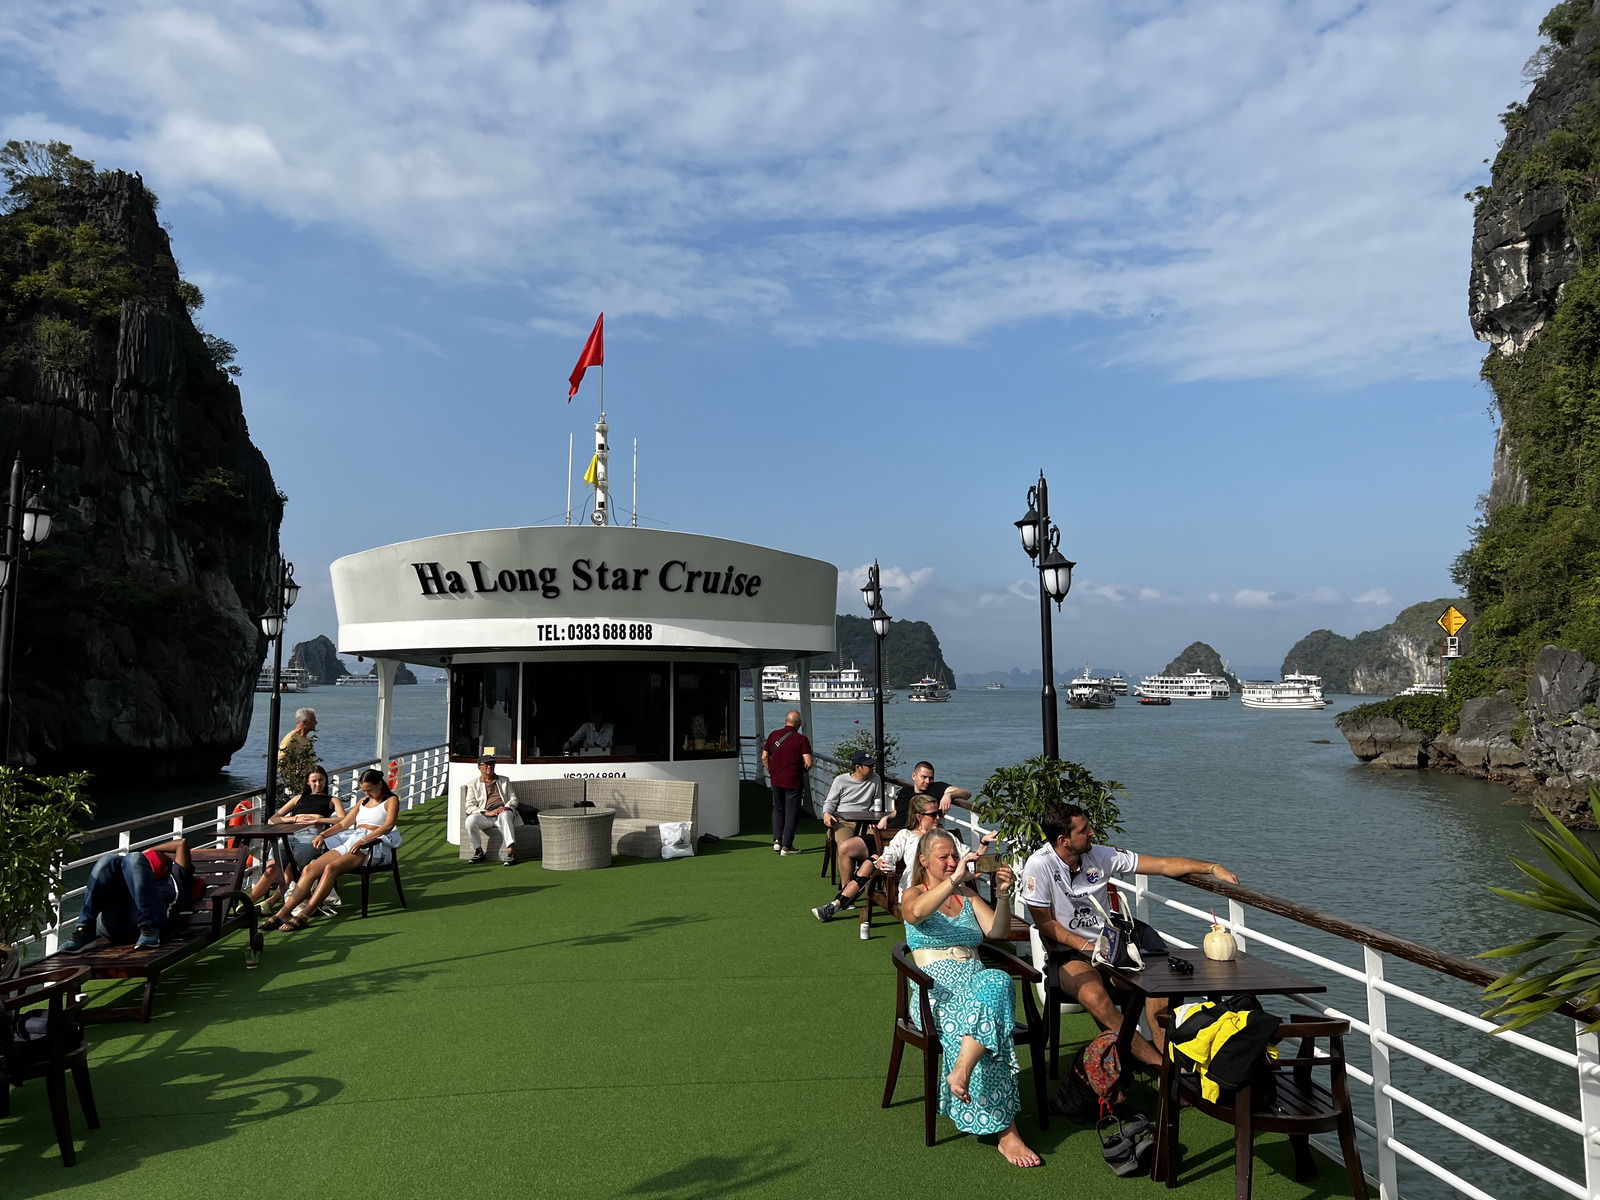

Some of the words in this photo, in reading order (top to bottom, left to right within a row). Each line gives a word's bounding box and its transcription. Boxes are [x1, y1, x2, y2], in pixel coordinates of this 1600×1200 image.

[411, 562, 466, 596] Ha
[467, 560, 560, 599] Long
[572, 559, 649, 591] Star
[658, 560, 762, 598] Cruise
[568, 624, 600, 641] 0383
[603, 624, 626, 641] 688
[629, 624, 653, 641] 888
